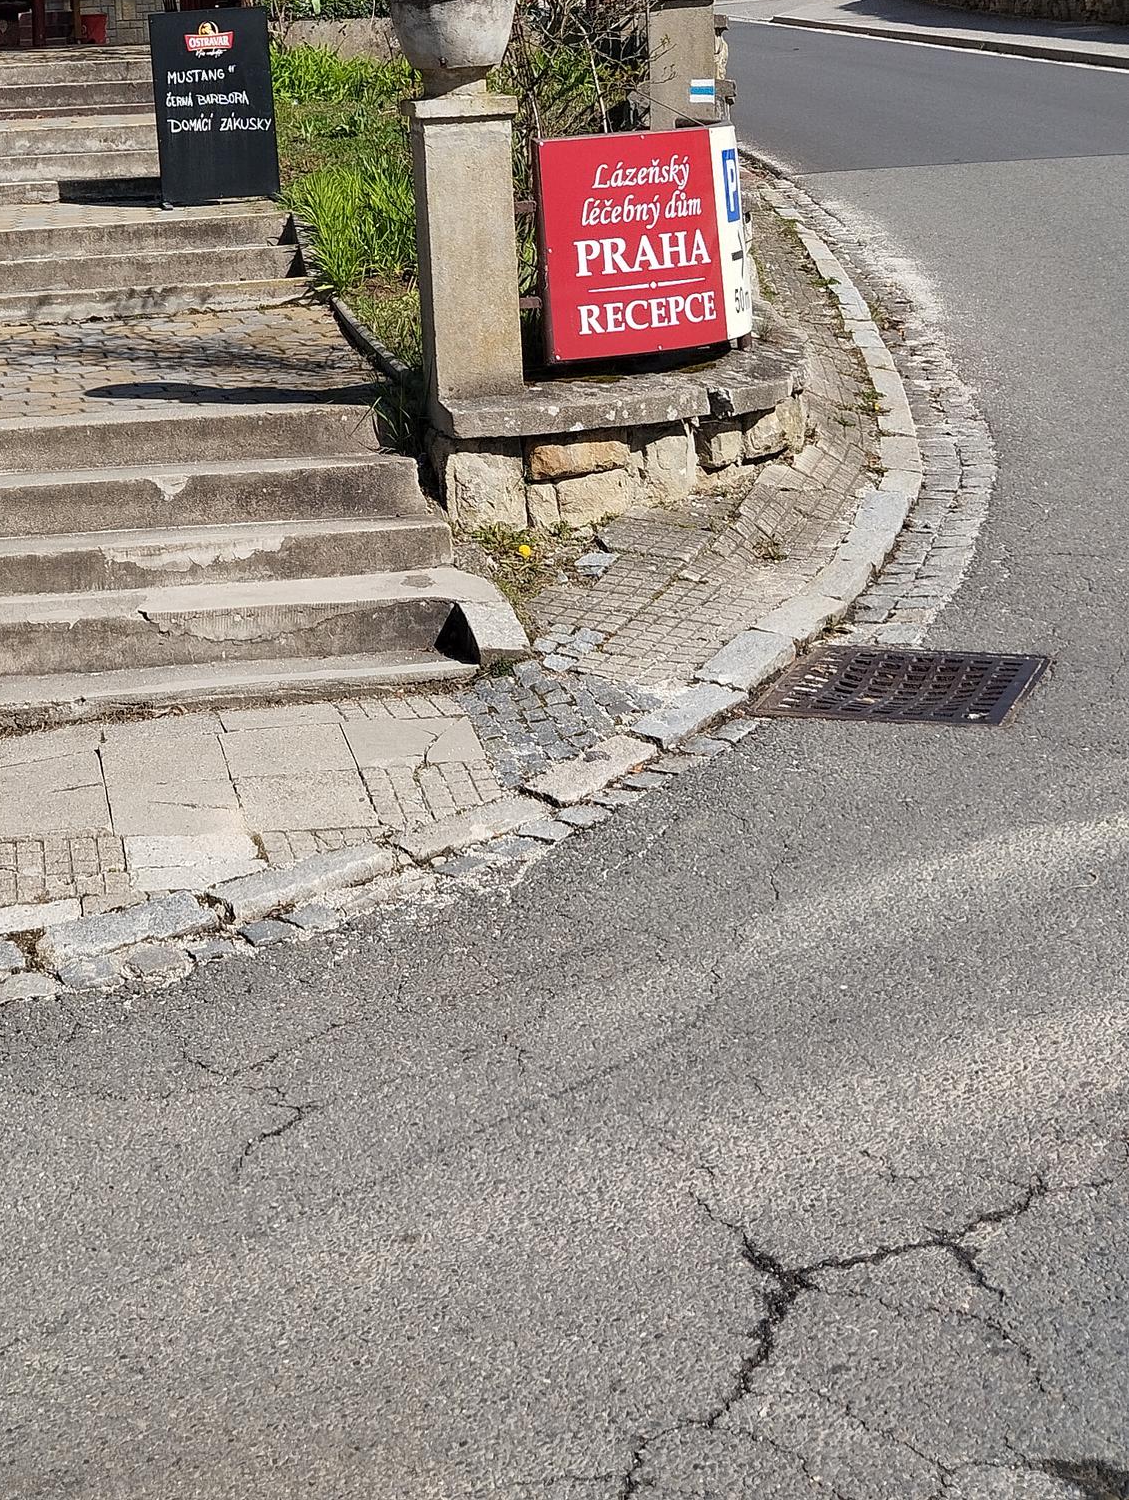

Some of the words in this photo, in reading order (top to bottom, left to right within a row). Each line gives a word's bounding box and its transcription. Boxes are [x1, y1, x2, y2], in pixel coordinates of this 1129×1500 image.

[188, 35, 230, 48] OSTRAVAR
[167, 68, 226, 85] MUSTANG
[165, 91, 194, 108] ČERNÁ
[195, 90, 250, 106] BARBORA
[166, 112, 214, 134] DOMÁCÍ
[219, 111, 272, 132] ZÁKUSKY
[591, 154, 691, 190] Lázeňský
[580, 193, 662, 230] léčebný
[664, 190, 702, 219] dům
[573, 228, 712, 278] PRAHA
[577, 291, 717, 336] RECEPCE
